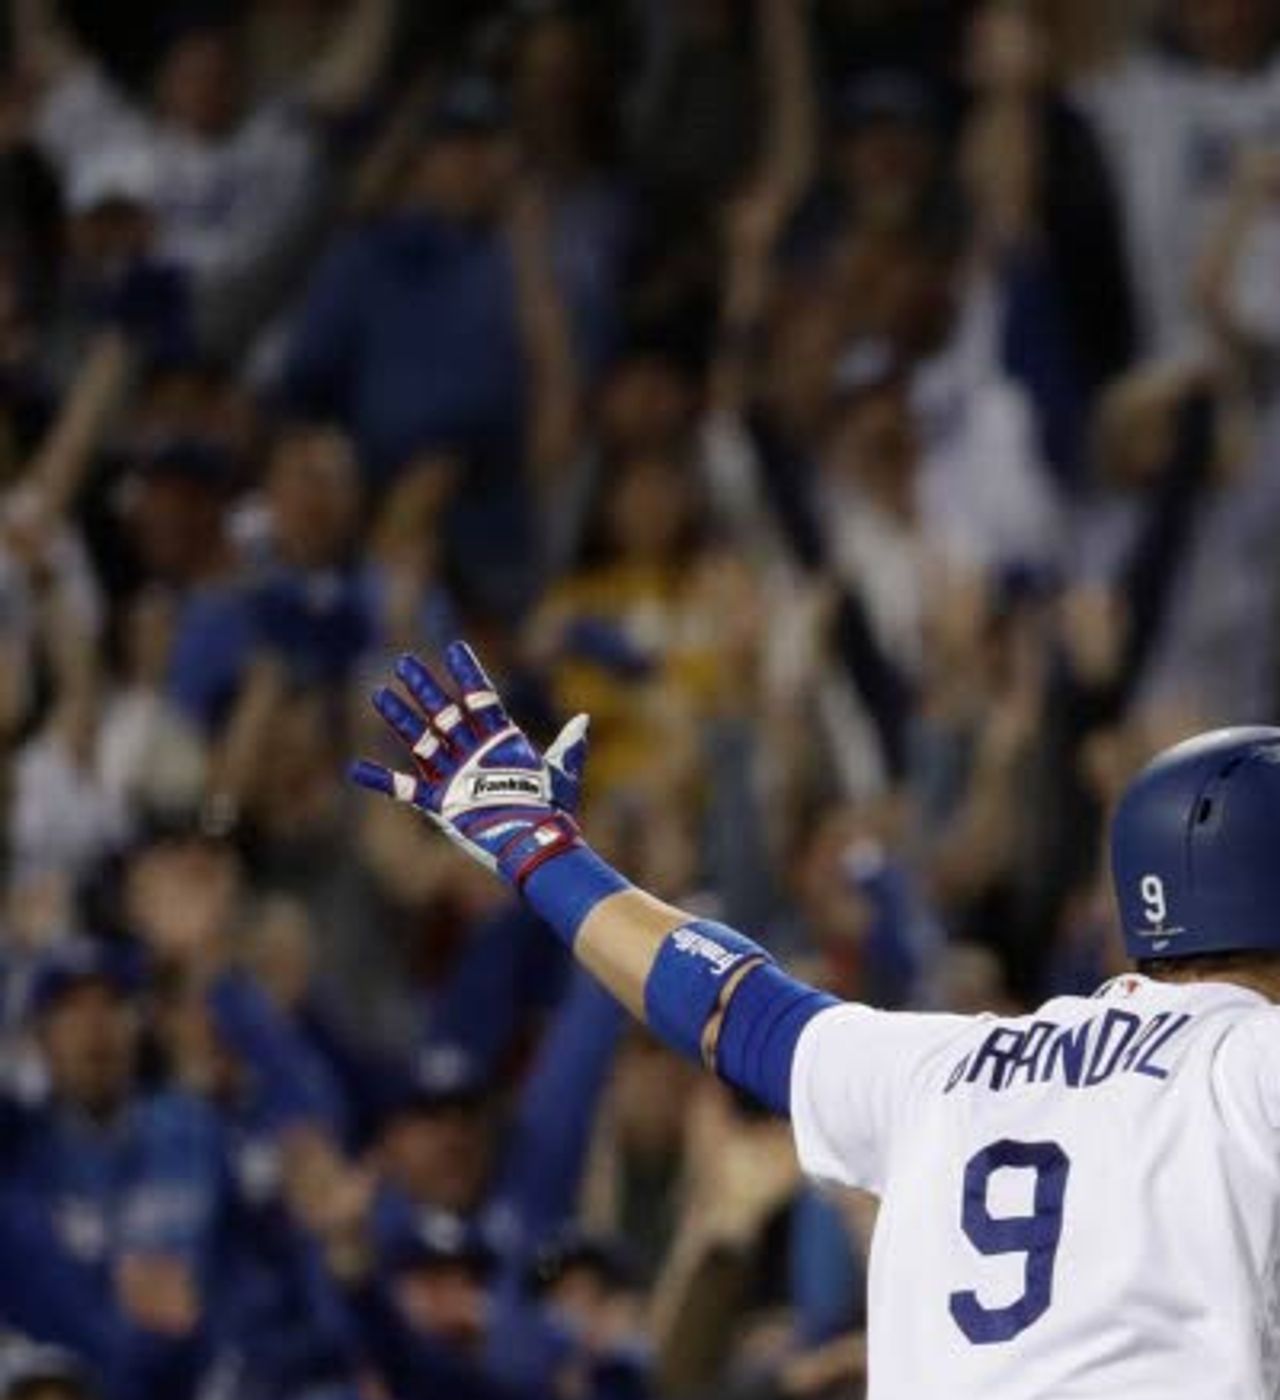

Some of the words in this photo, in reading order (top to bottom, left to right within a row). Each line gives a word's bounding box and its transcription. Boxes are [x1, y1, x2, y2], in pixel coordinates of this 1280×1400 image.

[1141, 874, 1167, 924] 9
[943, 1007, 1192, 1094] RANDAL
[947, 1138, 1071, 1346] 9
